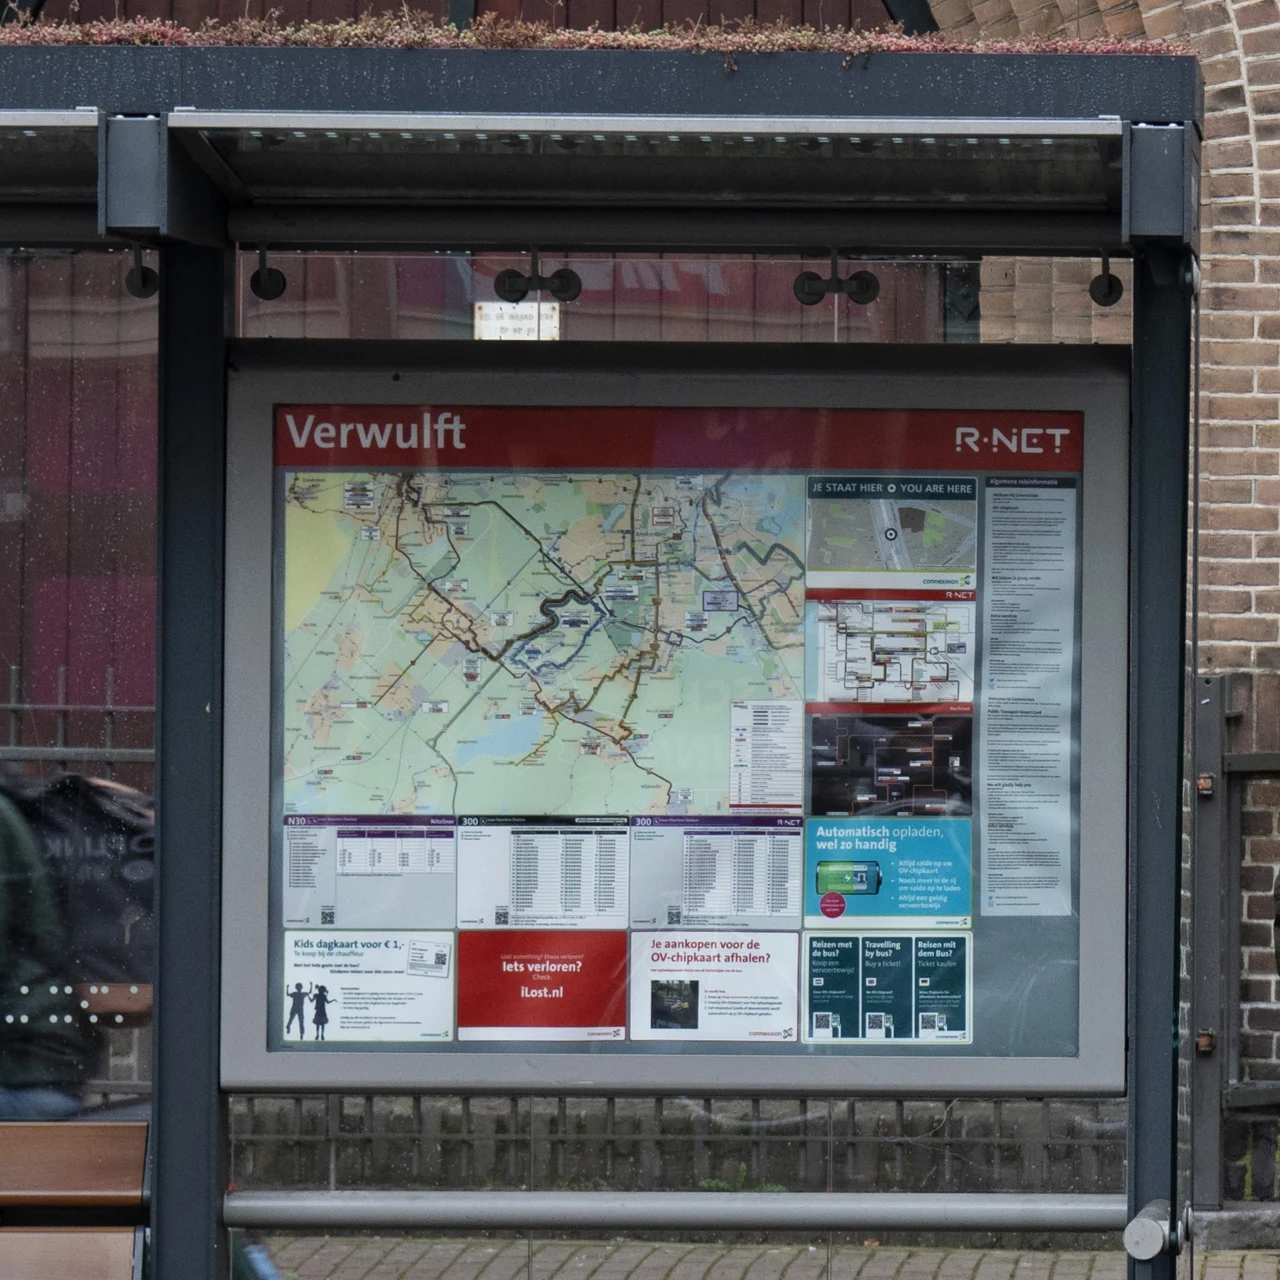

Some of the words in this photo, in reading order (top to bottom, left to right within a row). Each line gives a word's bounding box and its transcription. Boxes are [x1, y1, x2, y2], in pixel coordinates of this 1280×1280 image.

[285, 412, 466, 449] Verwulft
[812, 484, 823, 493] JE
[825, 483, 858, 492] STAAT
[860, 484, 883, 493] HIER
[901, 484, 923, 493] YOU
[925, 484, 945, 493] ARE
[947, 484, 972, 494] HERE
[288, 817, 306, 825] N30
[462, 817, 479, 825] 300
[635, 818, 652, 826] 300
[816, 827, 889, 837] Automatisch
[892, 827, 944, 839] opladen,
[816, 839, 838, 849] wel
[840, 841, 853, 849] zo
[855, 839, 897, 852] handig
[294, 939, 314, 949] Kids
[316, 939, 358, 951] dagkaart
[360, 941, 382, 949] voor
[384, 940, 391, 948] €
[651, 939, 662, 949] Je
[664, 939, 717, 952] aankopen
[720, 941, 744, 949] voor
[747, 939, 760, 949] de
[865, 941, 901, 950] Travelling
[651, 952, 721, 965] OV-chipkaart
[724, 953, 771, 963] afhalen?
[812, 949, 821, 957] de
[823, 949, 839, 957] bus?
[865, 950, 875, 959] by
[502, 961, 524, 972] Iets
[527, 960, 582, 972] verloren?
[521, 986, 563, 998] iLost.nl
